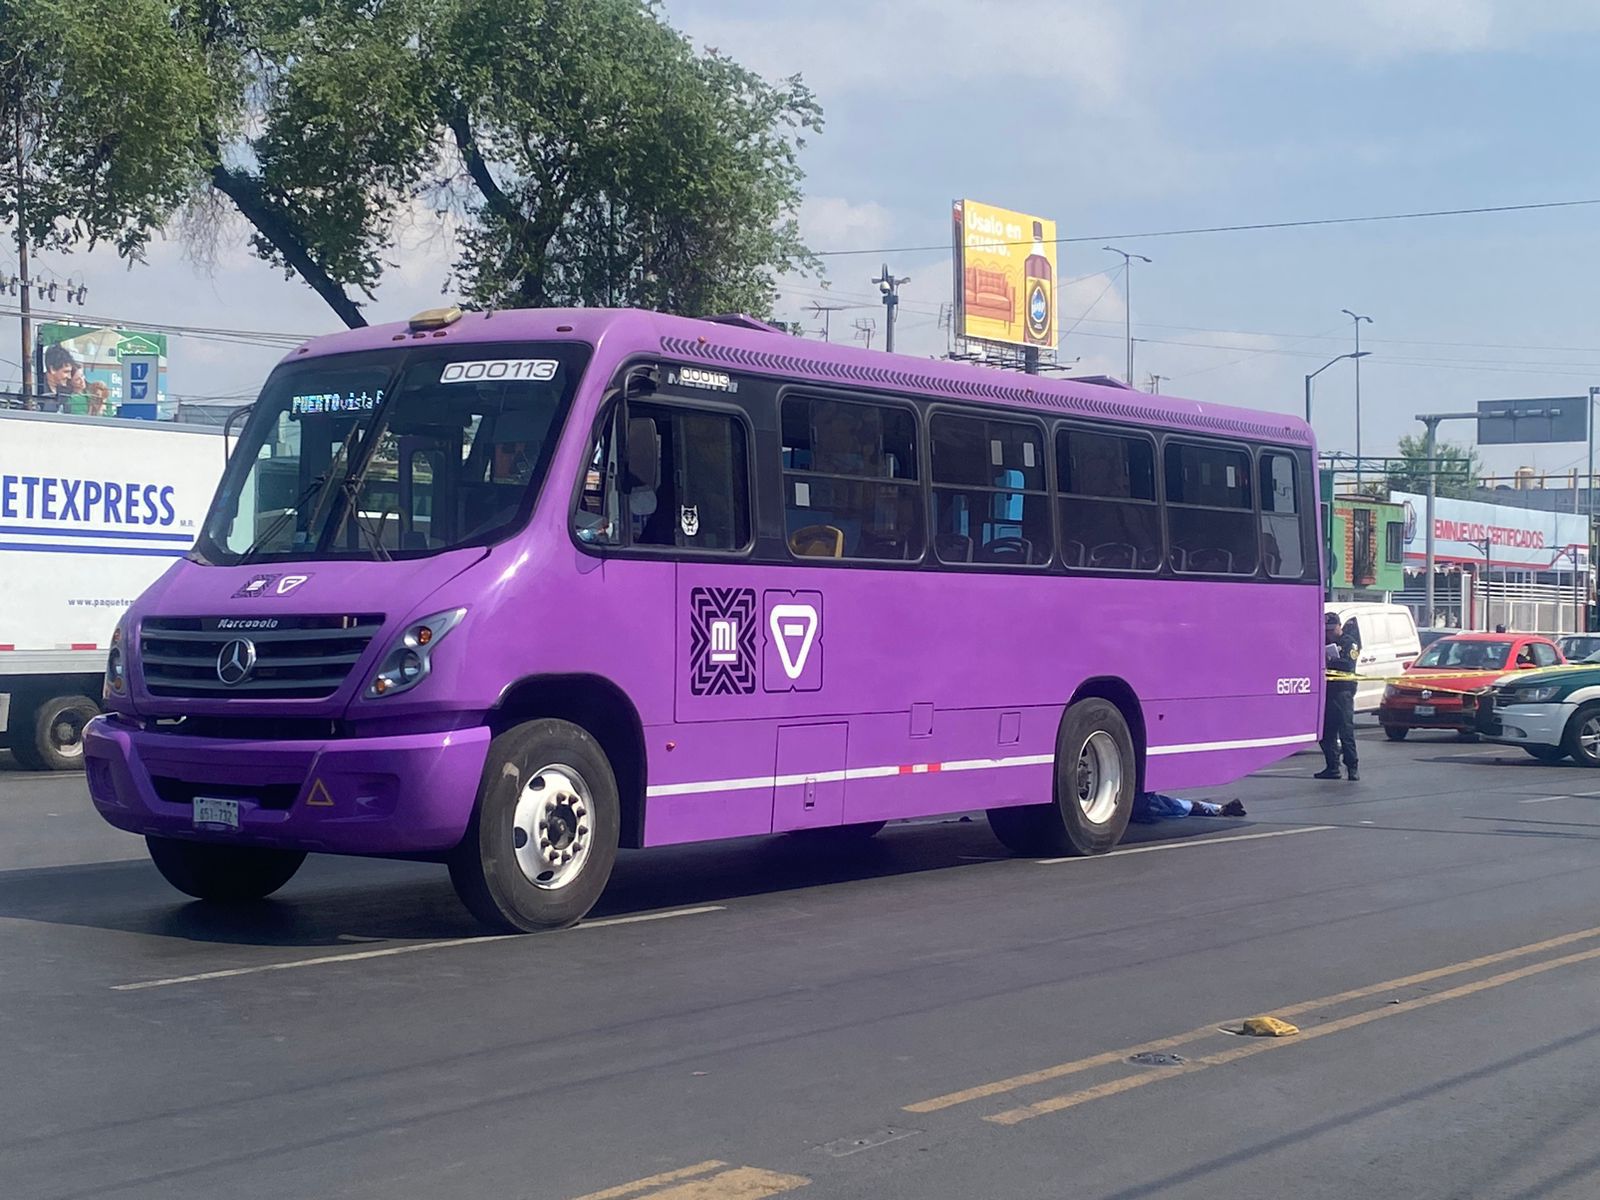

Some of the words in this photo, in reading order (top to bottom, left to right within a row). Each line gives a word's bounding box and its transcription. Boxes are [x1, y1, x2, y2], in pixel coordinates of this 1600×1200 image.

[1005, 223, 1022, 240] en
[443, 362, 556, 381] 000113
[682, 368, 729, 386] 000113
[2, 475, 175, 526] ETEXPRESS
[1434, 519, 1485, 542] EMINUEVOS
[1487, 525, 1544, 549] CERTIFICADOS
[1277, 677, 1311, 694] 651732
